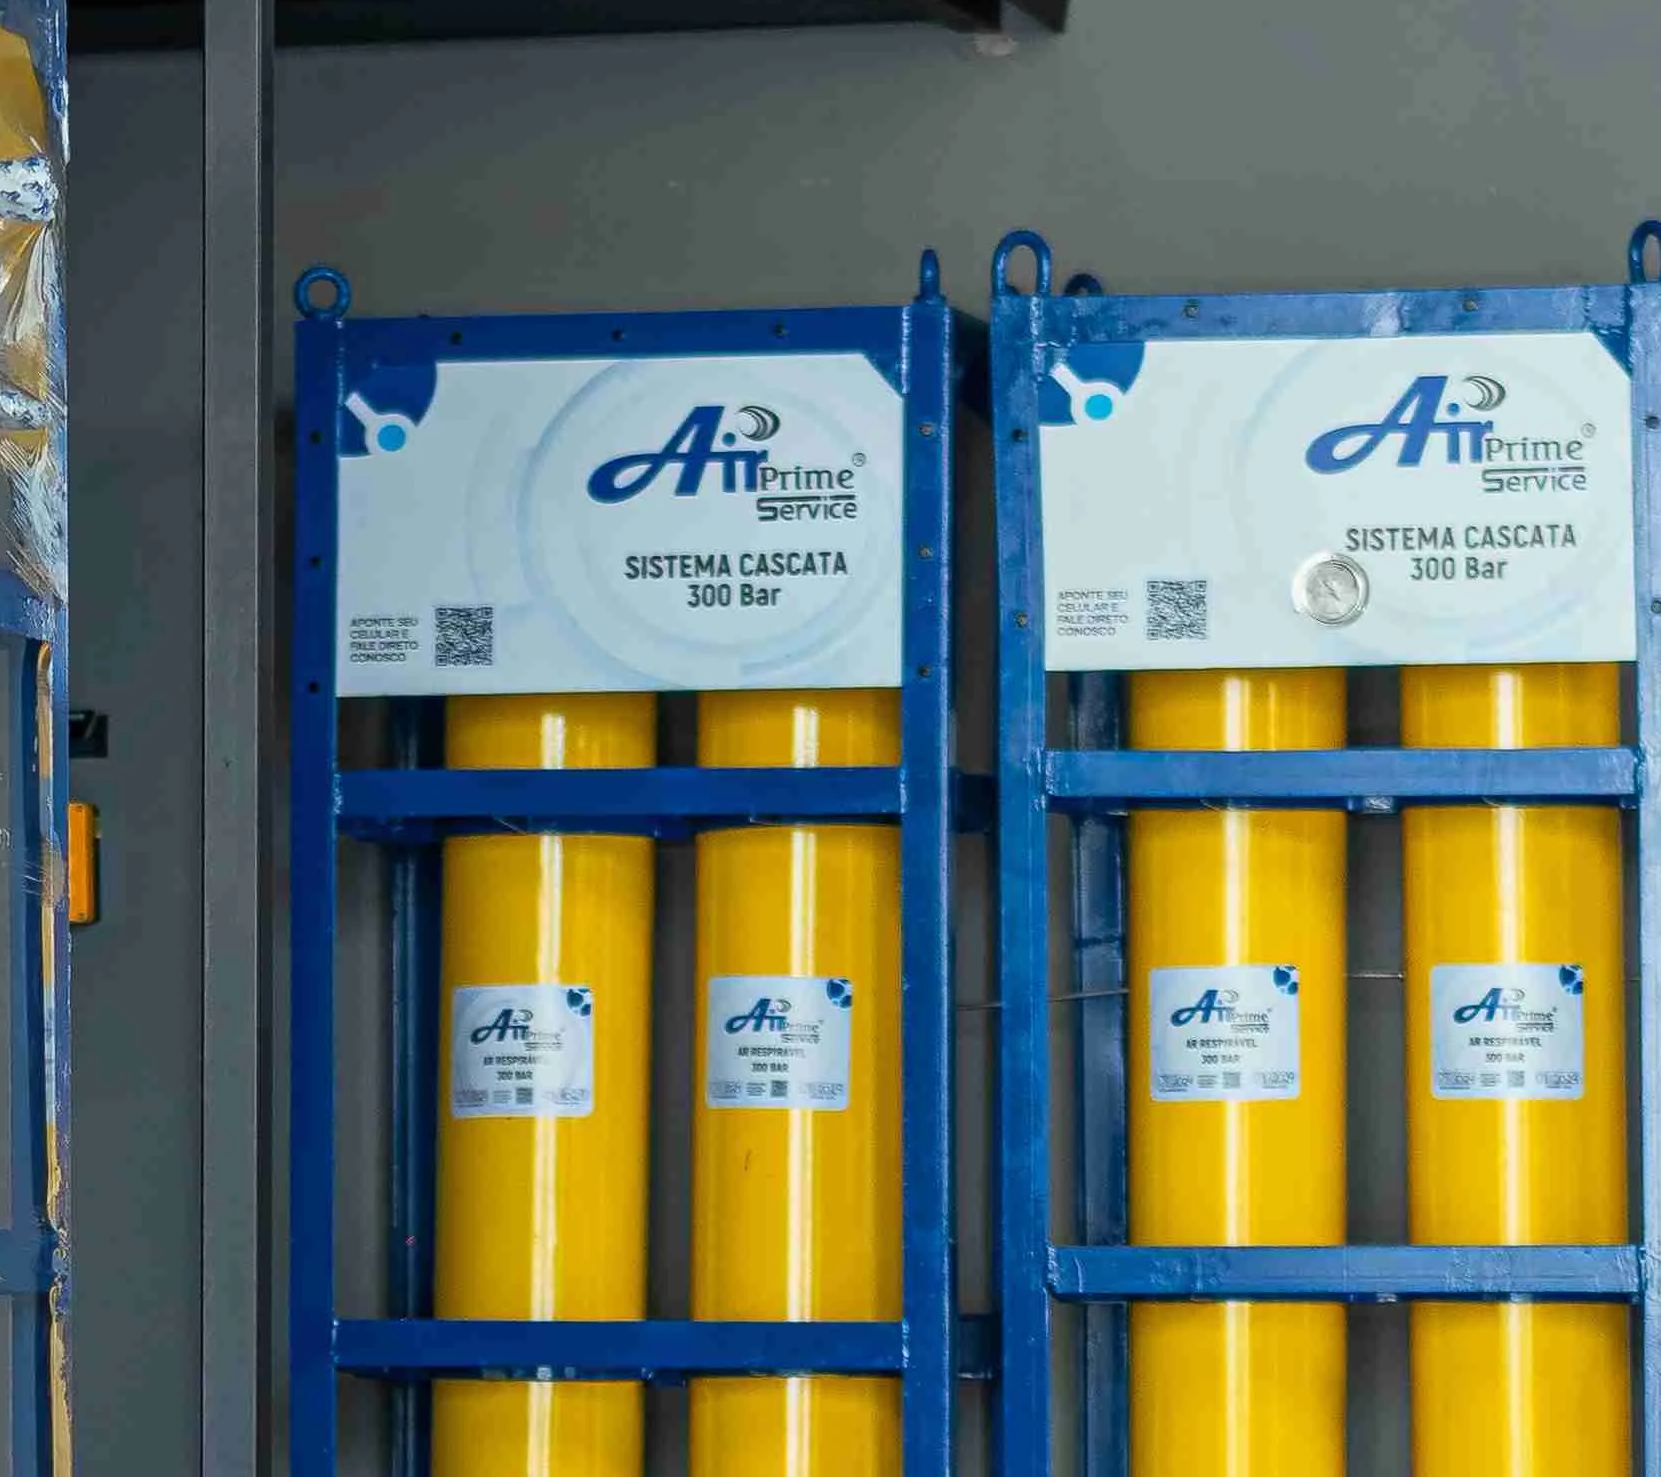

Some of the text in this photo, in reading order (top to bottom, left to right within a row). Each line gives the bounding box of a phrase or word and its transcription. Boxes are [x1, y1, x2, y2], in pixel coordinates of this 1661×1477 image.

[1305, 375, 1584, 474] Air Prime
[588, 405, 855, 504] Air Prime
[1481, 465, 1588, 493] Service
[756, 494, 857, 522] Service
[1345, 524, 1577, 553] SISTEMA CASCATA
[625, 552, 848, 580] SISTEMA CASCATA
[1410, 555, 1508, 582] 300 Bar
[687, 584, 781, 608] 300 Bar
